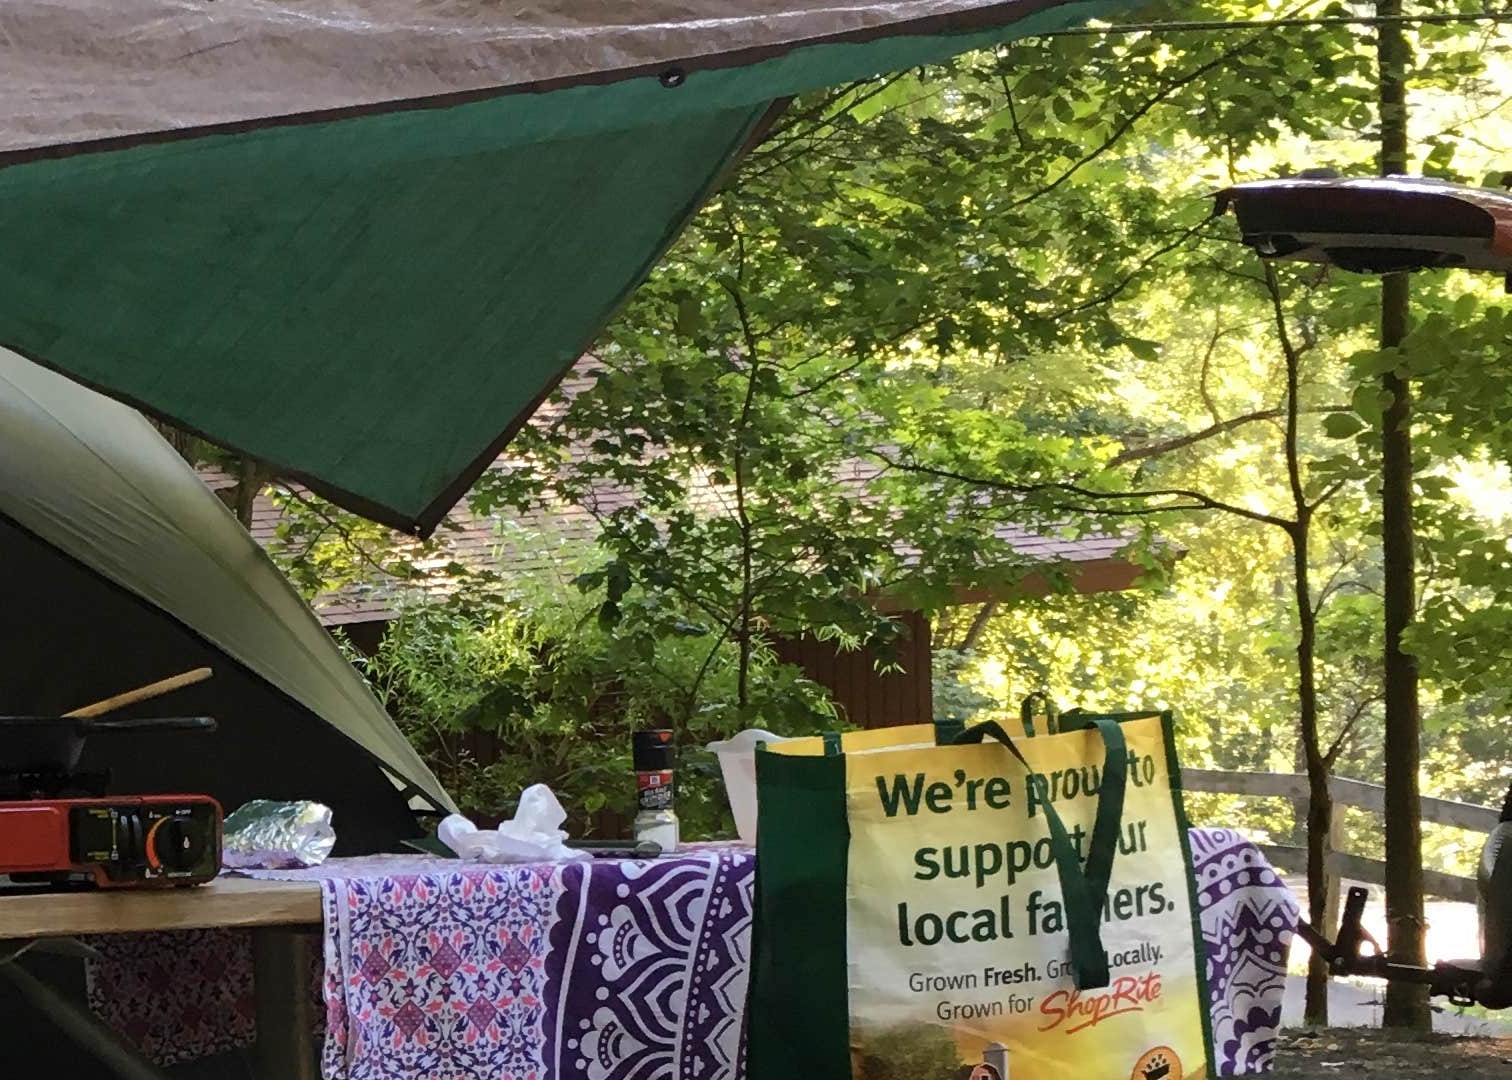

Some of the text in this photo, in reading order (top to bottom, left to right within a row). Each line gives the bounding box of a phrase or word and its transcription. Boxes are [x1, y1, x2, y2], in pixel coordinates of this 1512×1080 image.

[875, 749, 1155, 818] We're prou to
[914, 820, 1147, 889] suppot ur
[897, 881, 1175, 948] local faers.
[909, 971, 978, 993] Grown
[983, 962, 1042, 988] Fresh.
[1046, 959, 1073, 979] Gro
[937, 972, 1162, 1035] Grown for ShopRite
